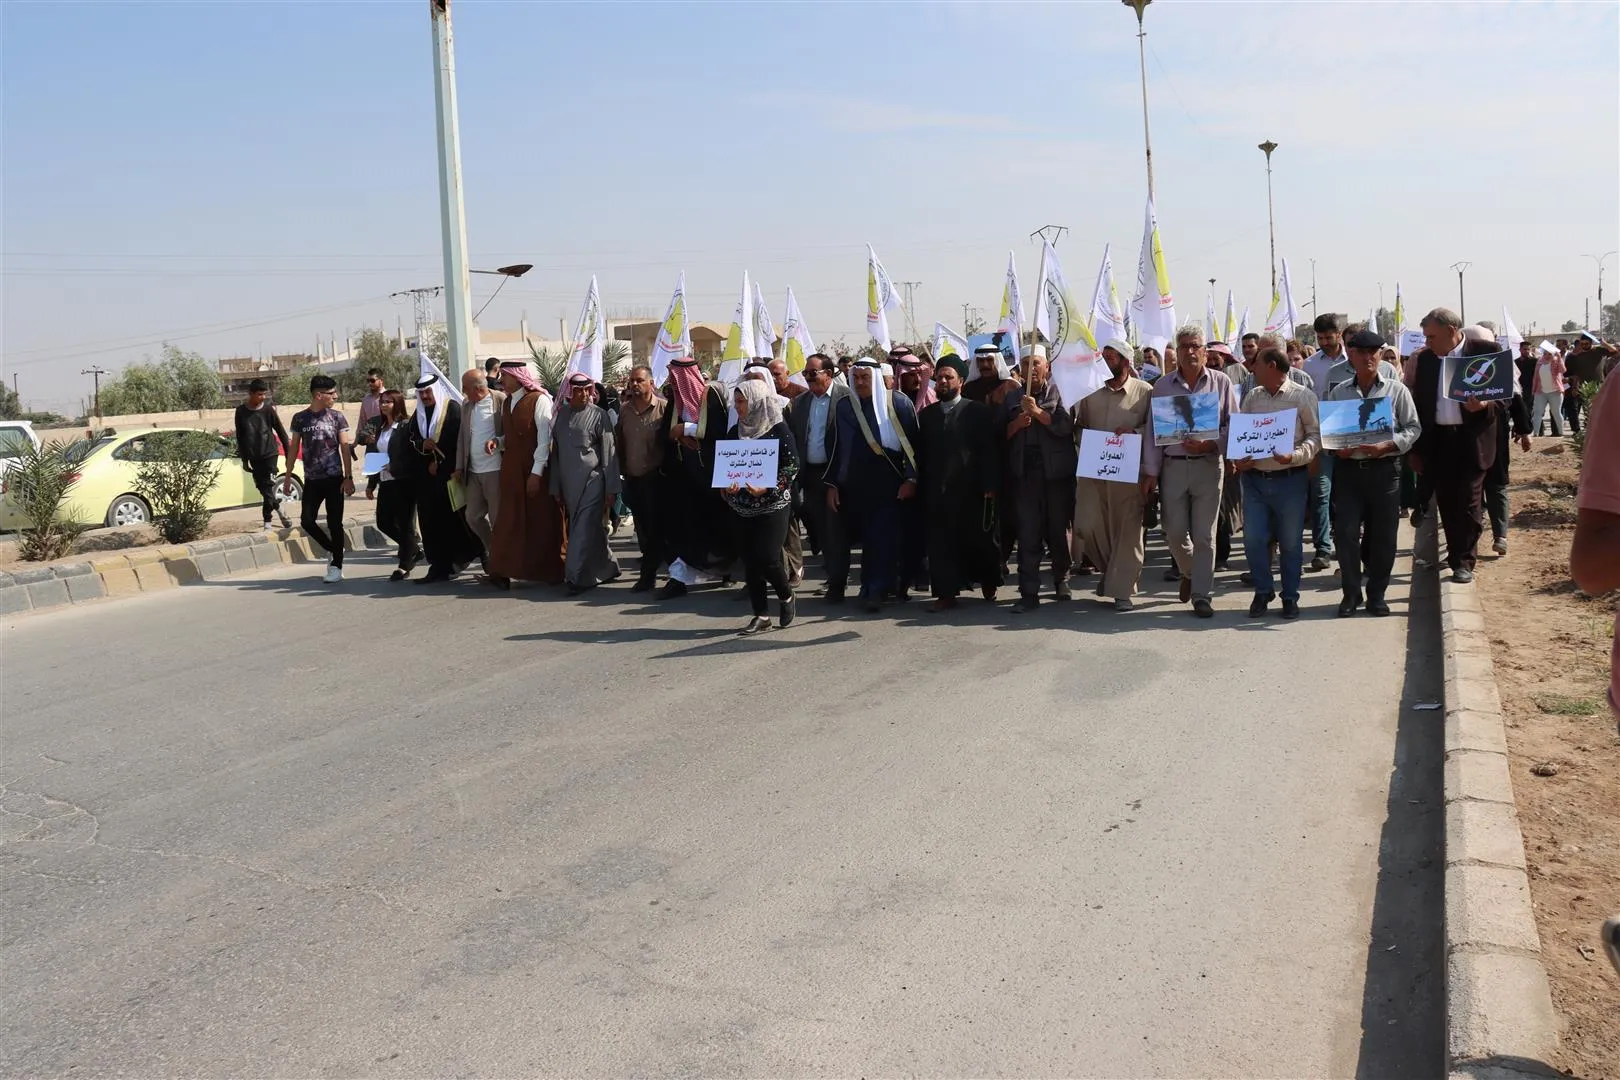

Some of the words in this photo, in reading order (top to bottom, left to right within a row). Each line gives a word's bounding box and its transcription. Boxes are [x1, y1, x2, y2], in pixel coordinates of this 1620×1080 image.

[1253, 417, 1276, 428] احظروا
[1237, 432, 1261, 442] التركي
[1264, 428, 1288, 440] الطيران
[750, 448, 767, 456] قامشلو
[1267, 444, 1275, 453] من
[718, 449, 740, 458] السويداء
[1100, 450, 1124, 460] العدوان
[730, 459, 747, 468] مشترك
[748, 459, 762, 468] نضال
[1097, 465, 1120, 476] التركي
[727, 471, 744, 480] الحرية
